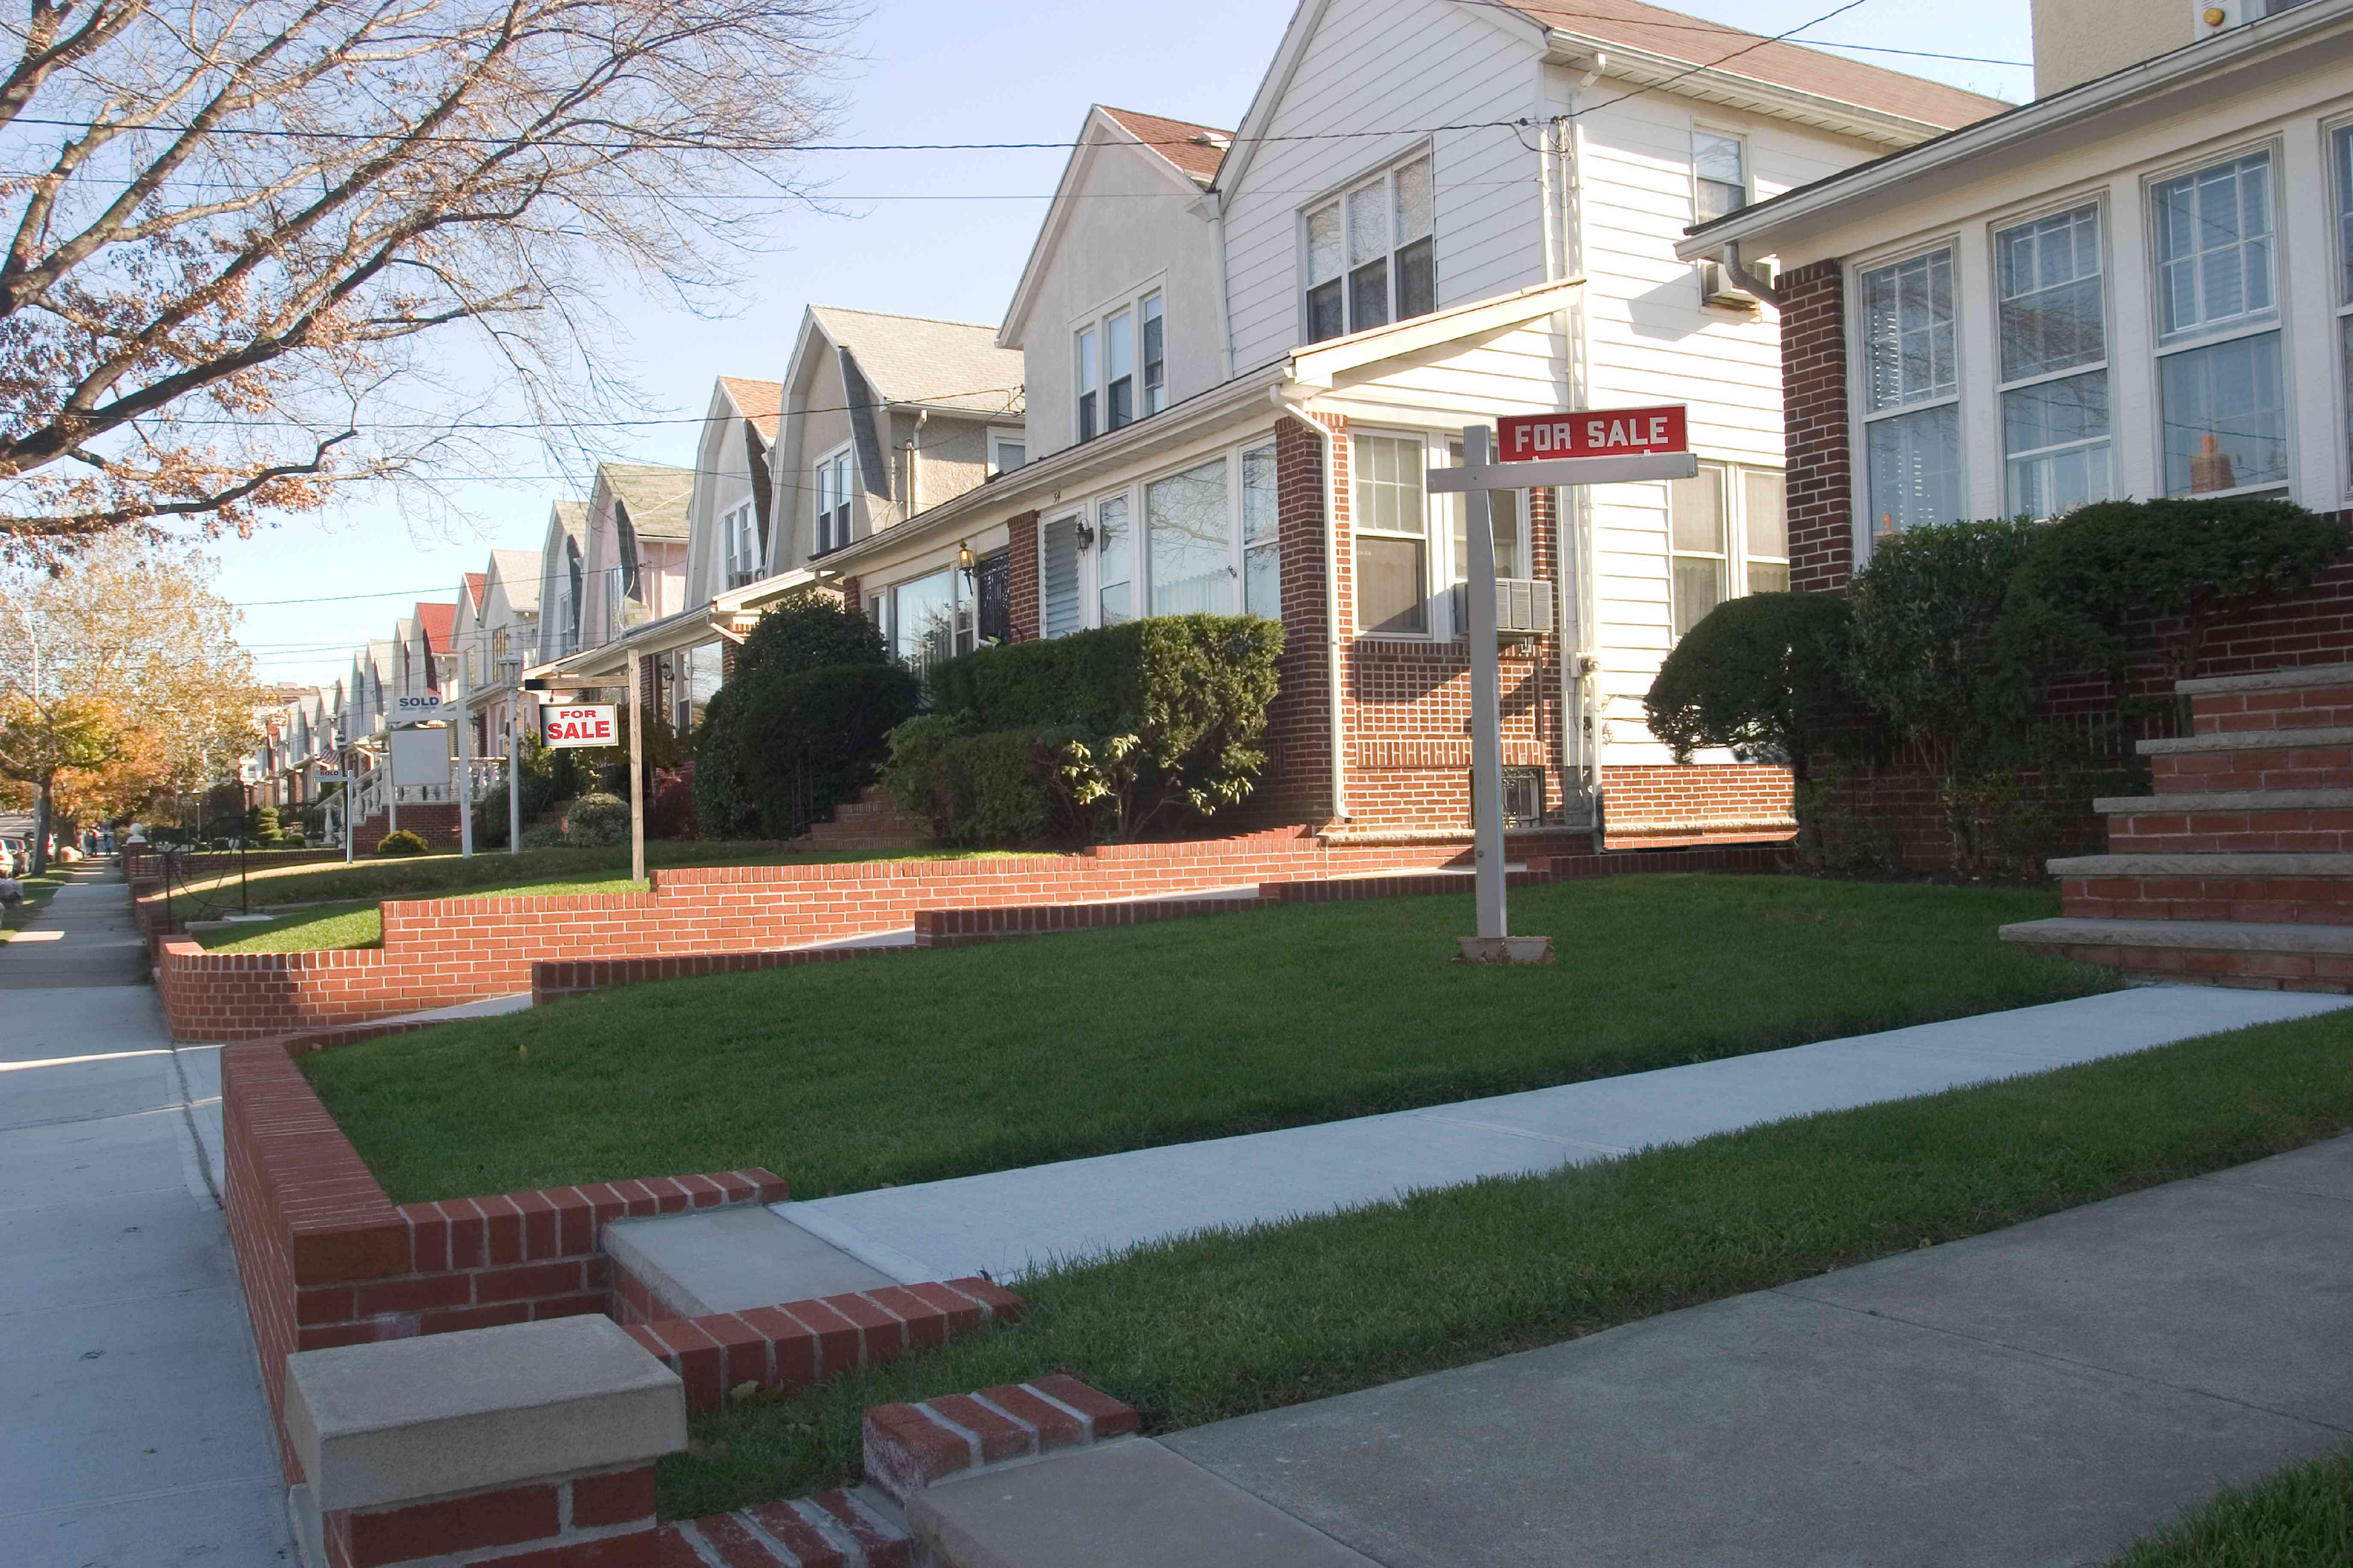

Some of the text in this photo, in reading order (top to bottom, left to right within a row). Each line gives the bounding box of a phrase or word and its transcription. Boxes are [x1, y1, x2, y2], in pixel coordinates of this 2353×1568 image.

[1515, 417, 1668, 452] FOR SALE
[399, 697, 439, 706] SOLD
[560, 710, 596, 719] FOR
[548, 721, 610, 740] SALE
